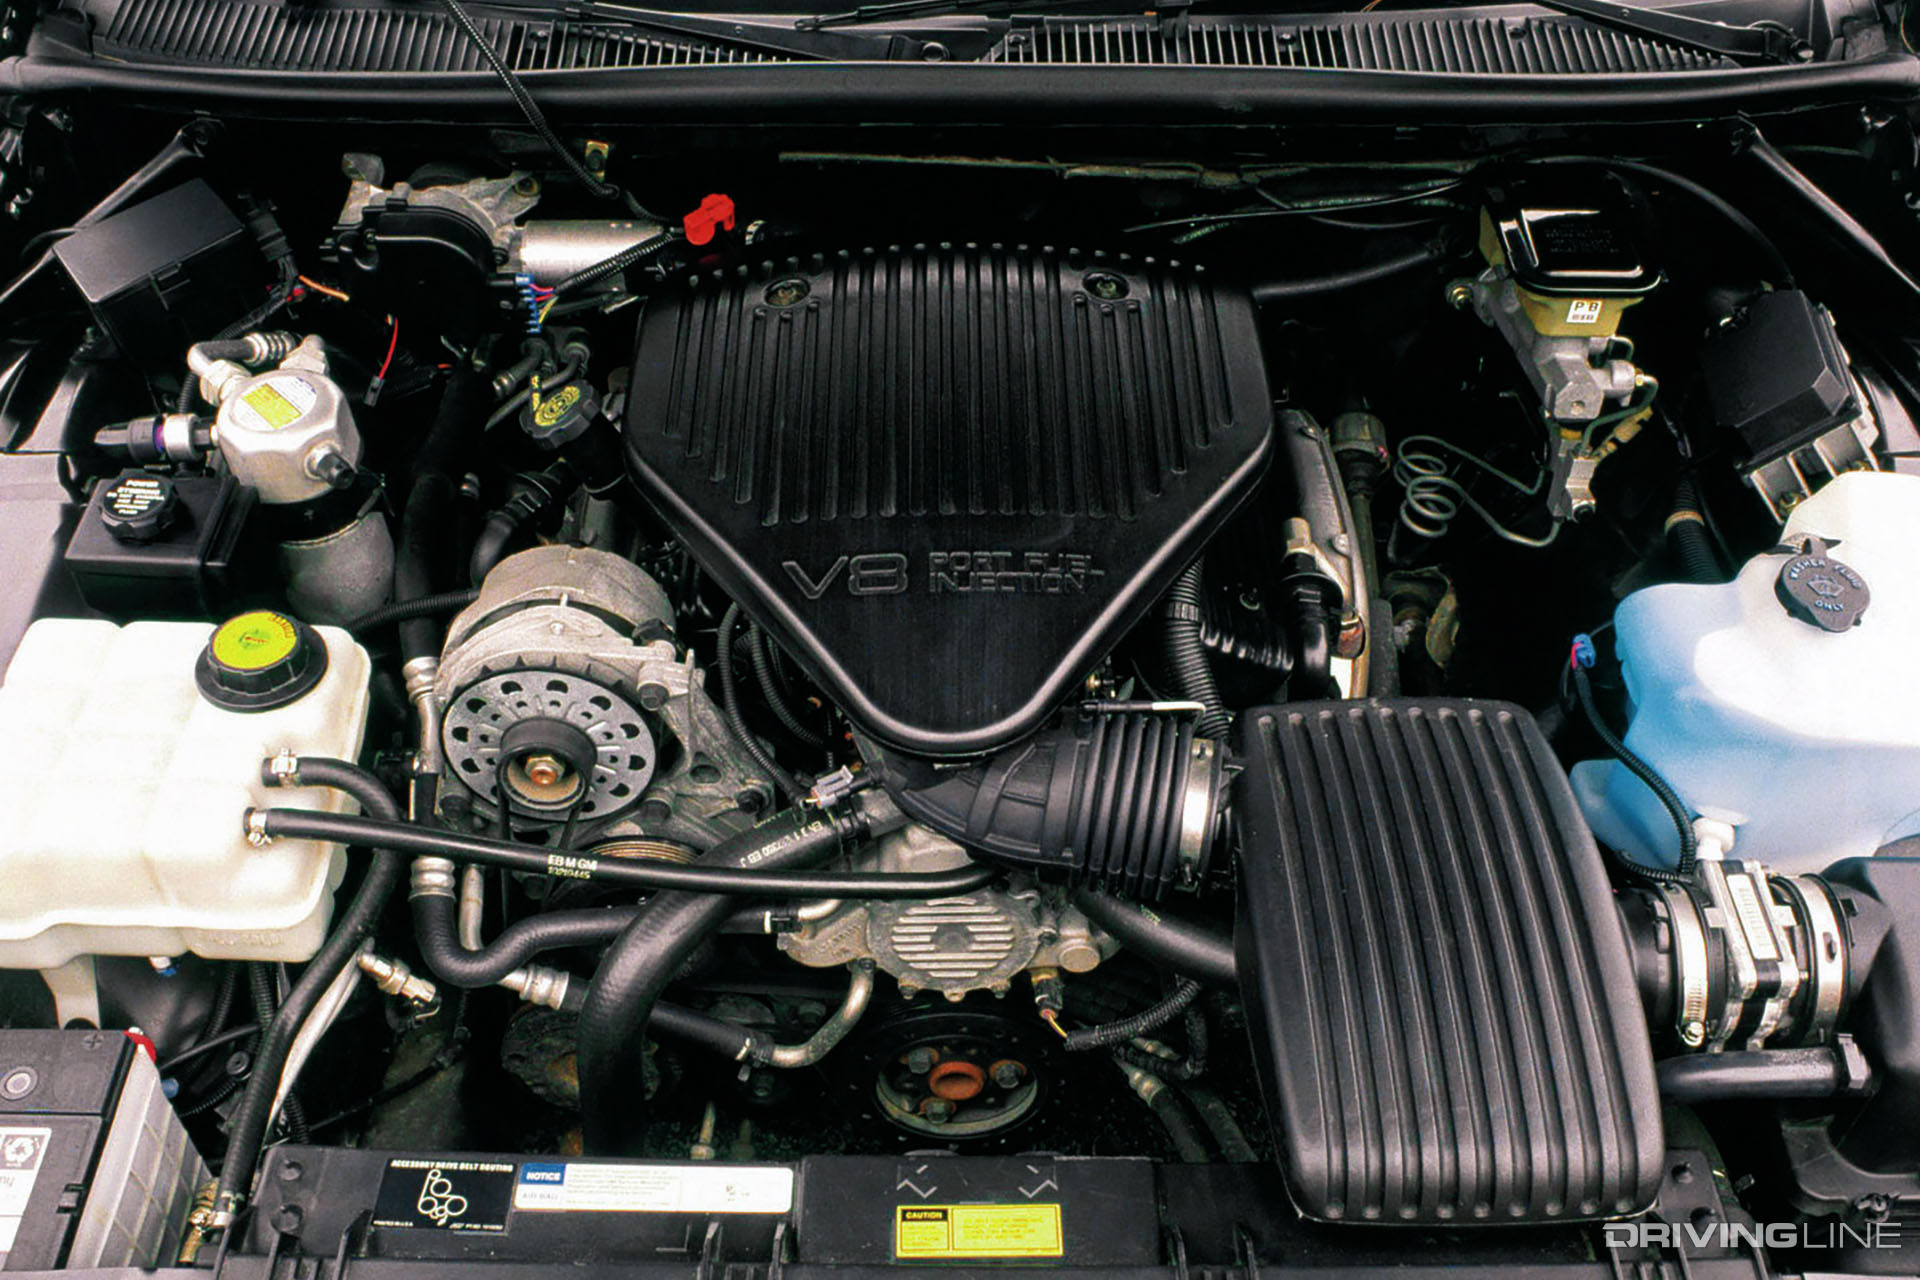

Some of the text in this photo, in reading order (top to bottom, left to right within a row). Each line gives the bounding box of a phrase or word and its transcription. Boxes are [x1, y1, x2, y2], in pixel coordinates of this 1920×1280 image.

[929, 551, 1013, 572] PORT
[782, 553, 908, 600] V8
[929, 571, 1092, 594] INJECTION
[1814, 599, 1844, 613] ONLY
[459, 1162, 479, 1171] BELT
[526, 1171, 561, 1181] NOTICE
[905, 1210, 943, 1220] CAUTION
